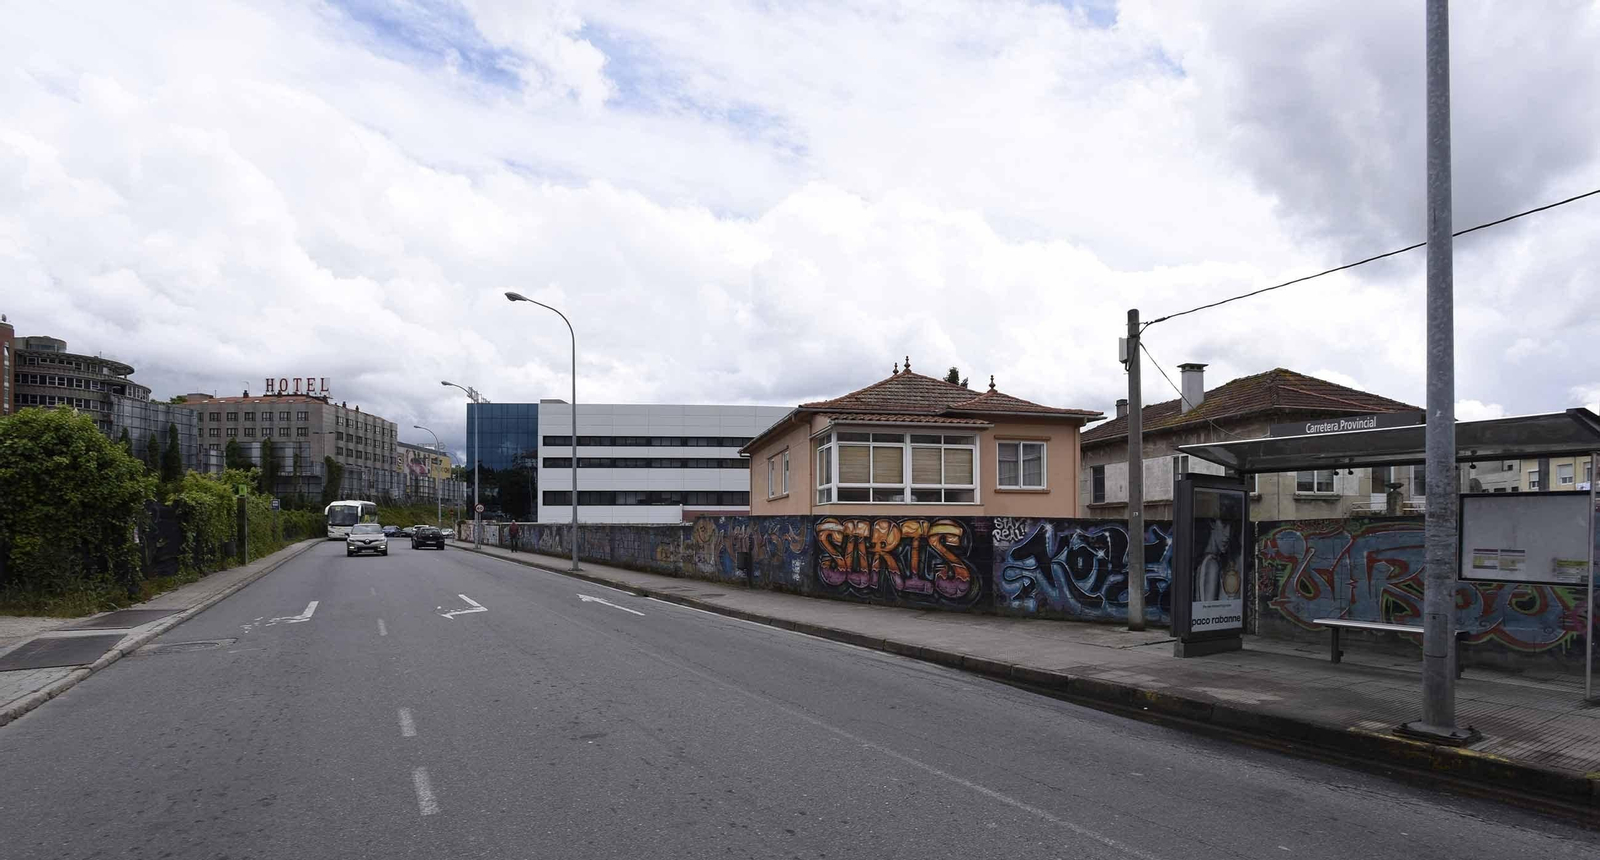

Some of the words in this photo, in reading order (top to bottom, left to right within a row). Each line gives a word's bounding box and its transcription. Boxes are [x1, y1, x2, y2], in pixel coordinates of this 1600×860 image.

[265, 377, 329, 392] HOTEL
[1305, 422, 1339, 433] Carretera
[1340, 416, 1377, 430] Provincial
[1191, 618, 1211, 626] paco
[1211, 615, 1242, 624] rabanne
